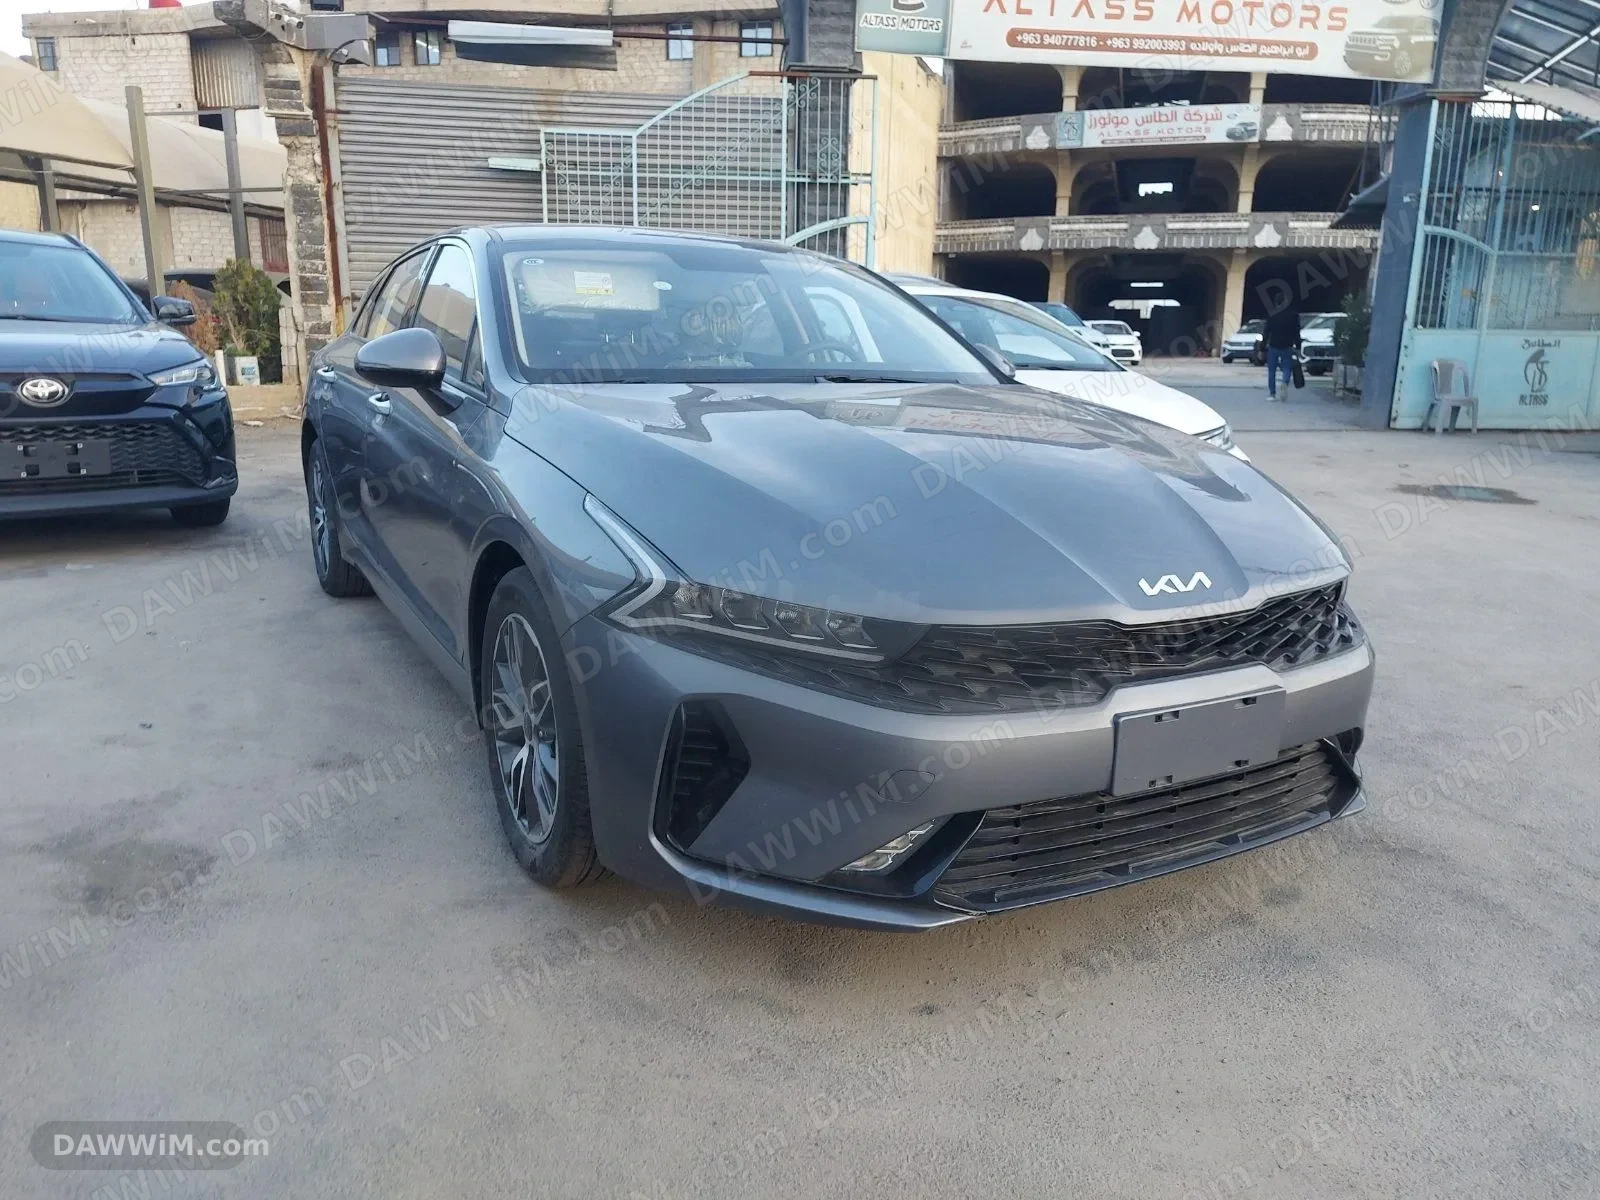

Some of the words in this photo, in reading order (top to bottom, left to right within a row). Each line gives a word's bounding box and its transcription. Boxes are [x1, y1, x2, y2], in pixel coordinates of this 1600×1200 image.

[861, 15, 897, 28] ALTASS
[900, 17, 942, 31] MOTORS
[1176, 0, 1348, 32] MOTORS
[1016, 32, 1041, 45] +963
[1106, 37, 1131, 49] +963
[1135, 110, 1178, 127] الطاس
[1184, 107, 1223, 124] شركة
